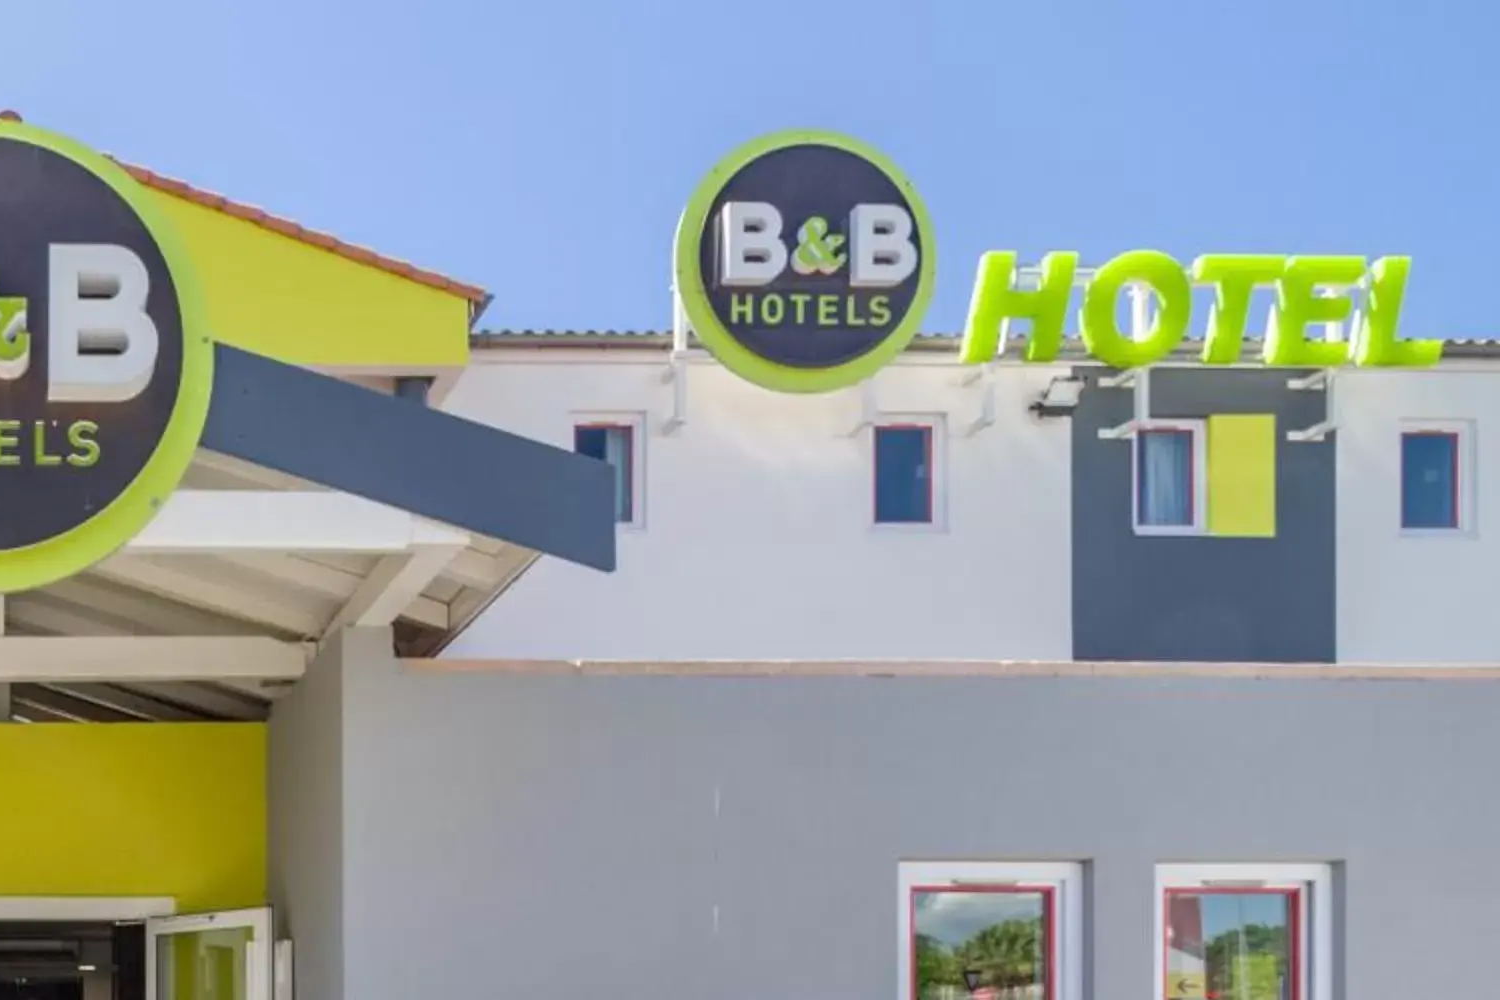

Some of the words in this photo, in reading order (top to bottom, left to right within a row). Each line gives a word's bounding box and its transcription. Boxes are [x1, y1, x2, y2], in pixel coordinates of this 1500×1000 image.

[717, 200, 918, 287] B&B
[729, 293, 892, 326] HOTELS
[959, 249, 1444, 368] HOTEL
